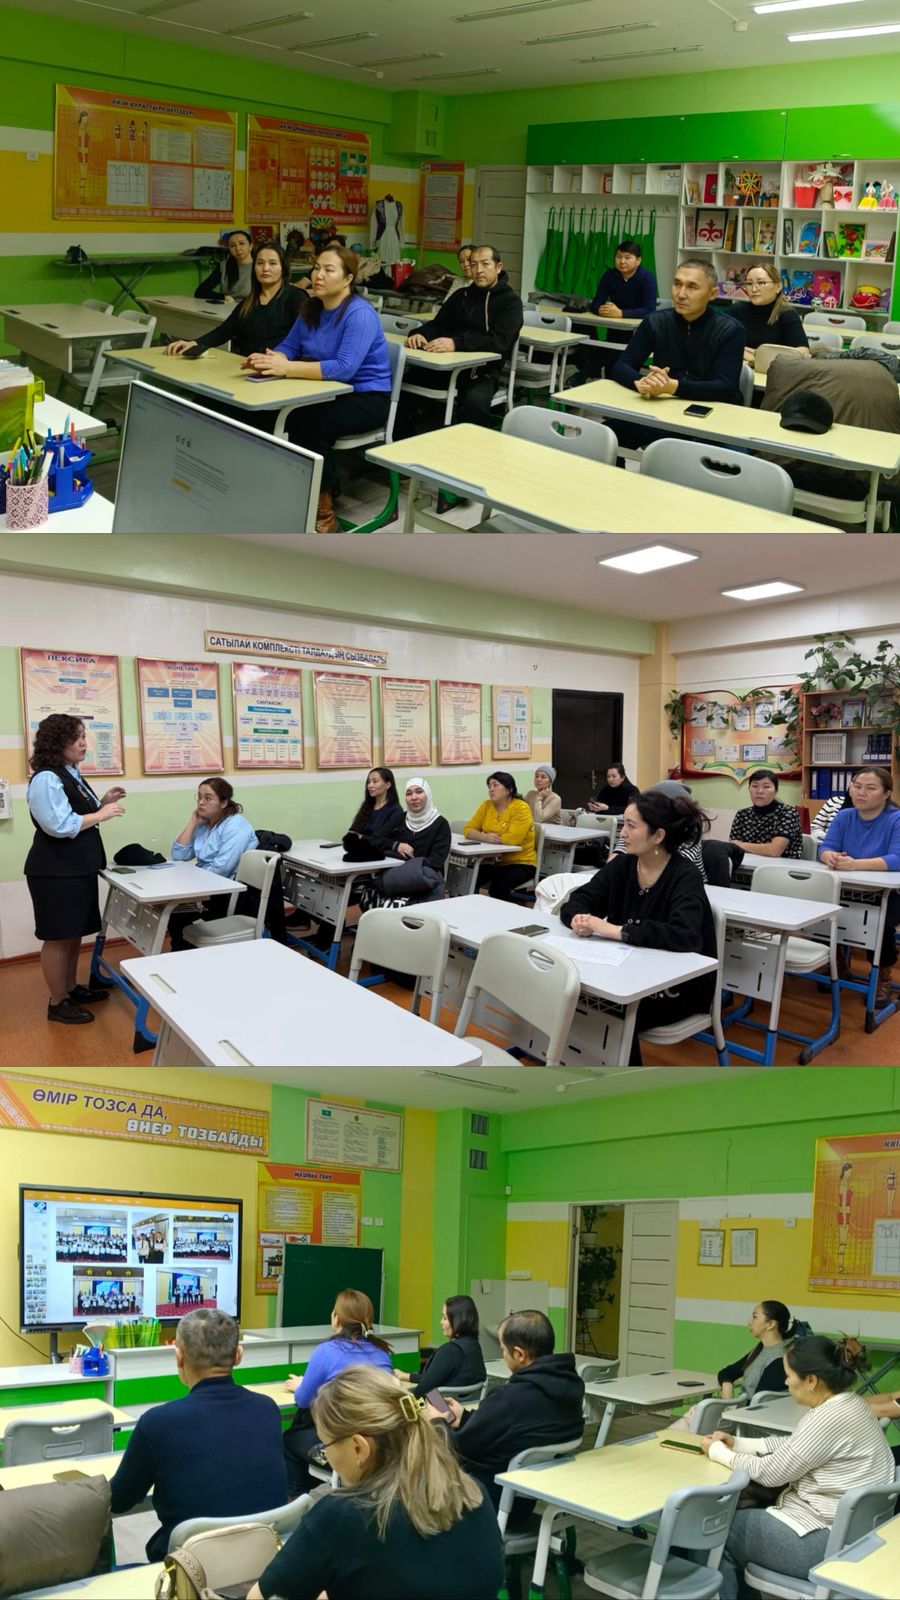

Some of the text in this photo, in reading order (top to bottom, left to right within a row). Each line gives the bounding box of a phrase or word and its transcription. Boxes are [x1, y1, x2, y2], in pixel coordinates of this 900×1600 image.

[47, 654, 96, 664] ЛЕКСИКА
[209, 636, 251, 649] САТЫЛАЙ
[253, 641, 301, 655] КОМПЛЕКСТІ
[345, 652, 387, 664] СЫЗБАЛАРЫ
[32, 1089, 168, 1120] ӨМІР ТОЗСА ДА,
[126, 1120, 264, 1148] ӨНЕР ТОЗБАЙДЫ
